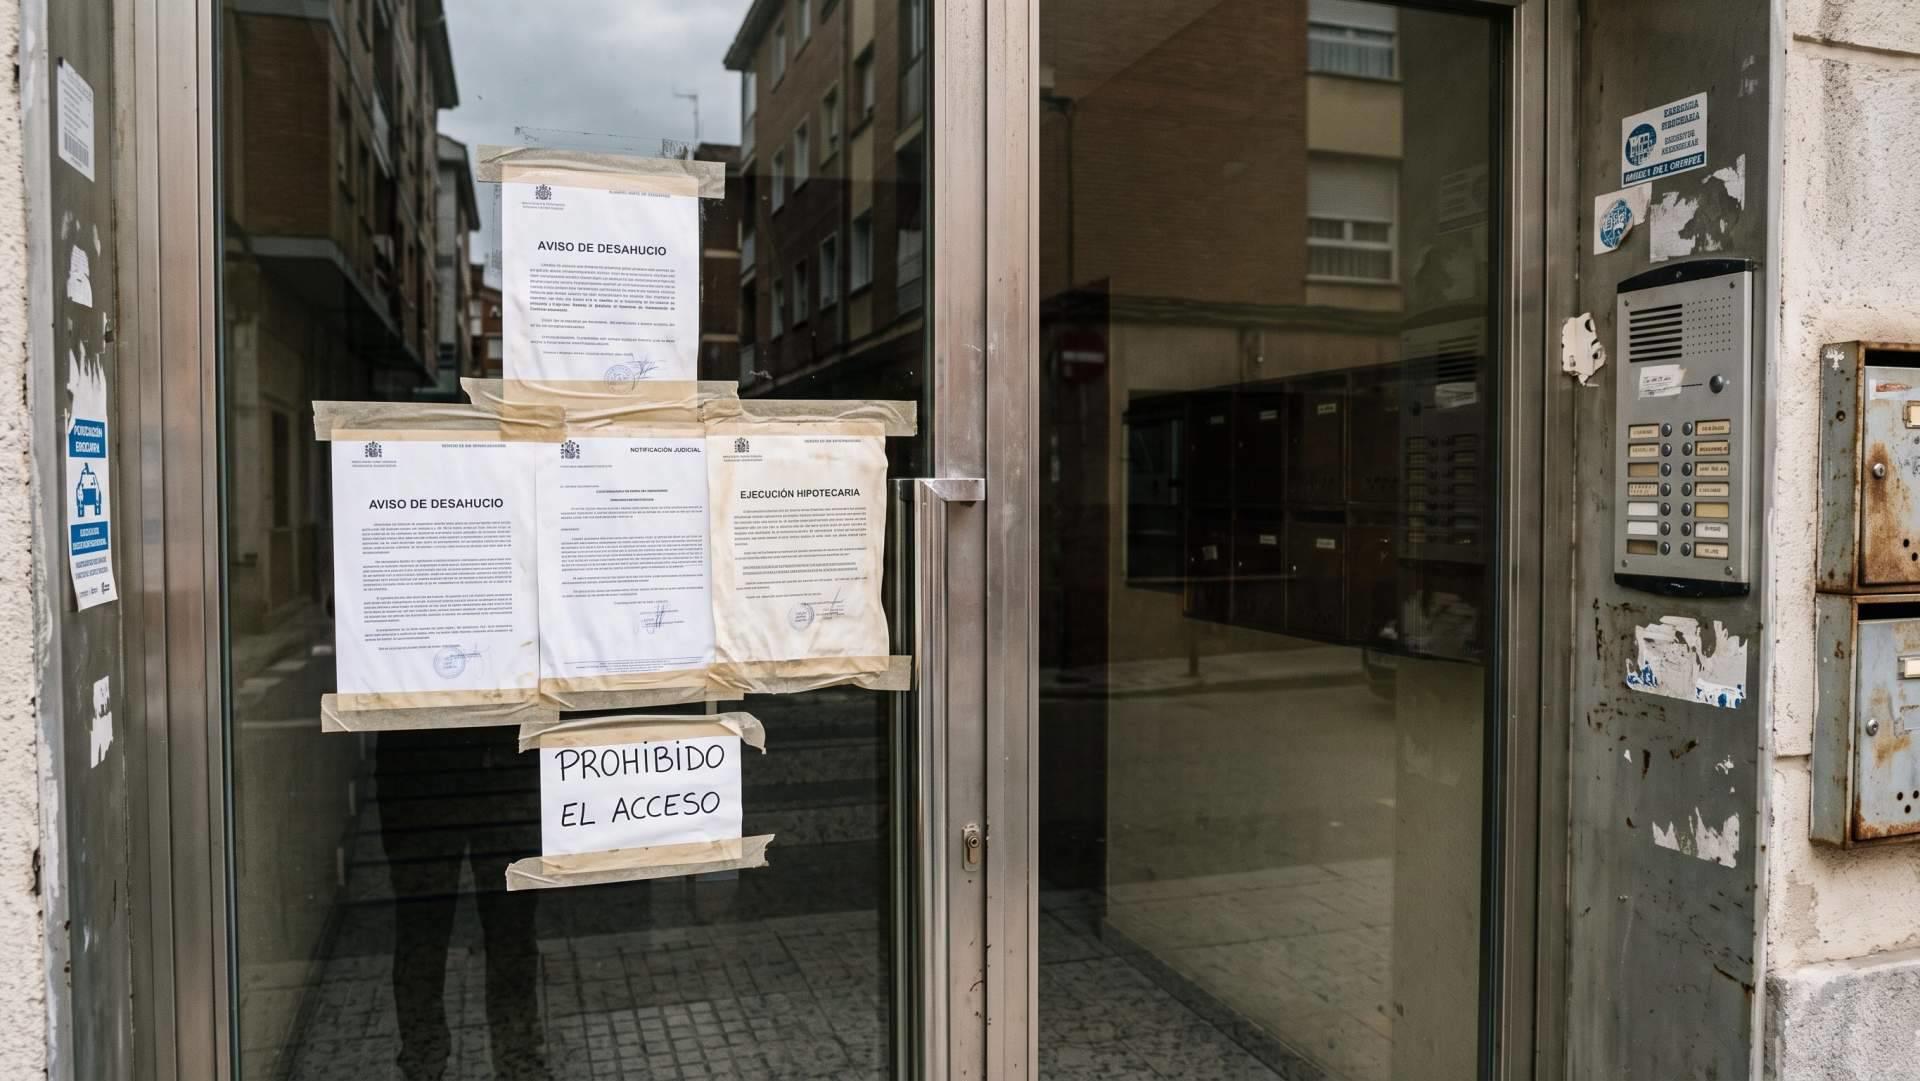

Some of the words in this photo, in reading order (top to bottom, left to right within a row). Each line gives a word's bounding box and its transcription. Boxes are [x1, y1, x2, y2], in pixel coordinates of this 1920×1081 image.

[537, 240, 575, 252] AVISO
[578, 242, 594, 253] DE
[597, 243, 667, 256] DESAHUCIO
[740, 487, 795, 499] EJECUCIÓN
[796, 488, 861, 498] HIPOTECARIA
[369, 499, 407, 509] AVISO
[410, 499, 428, 509] DE
[431, 498, 504, 509] DESAHUCIO
[554, 740, 725, 781] PROHIBIDO
[561, 802, 596, 827] EL
[611, 791, 721, 823] ACCESO
